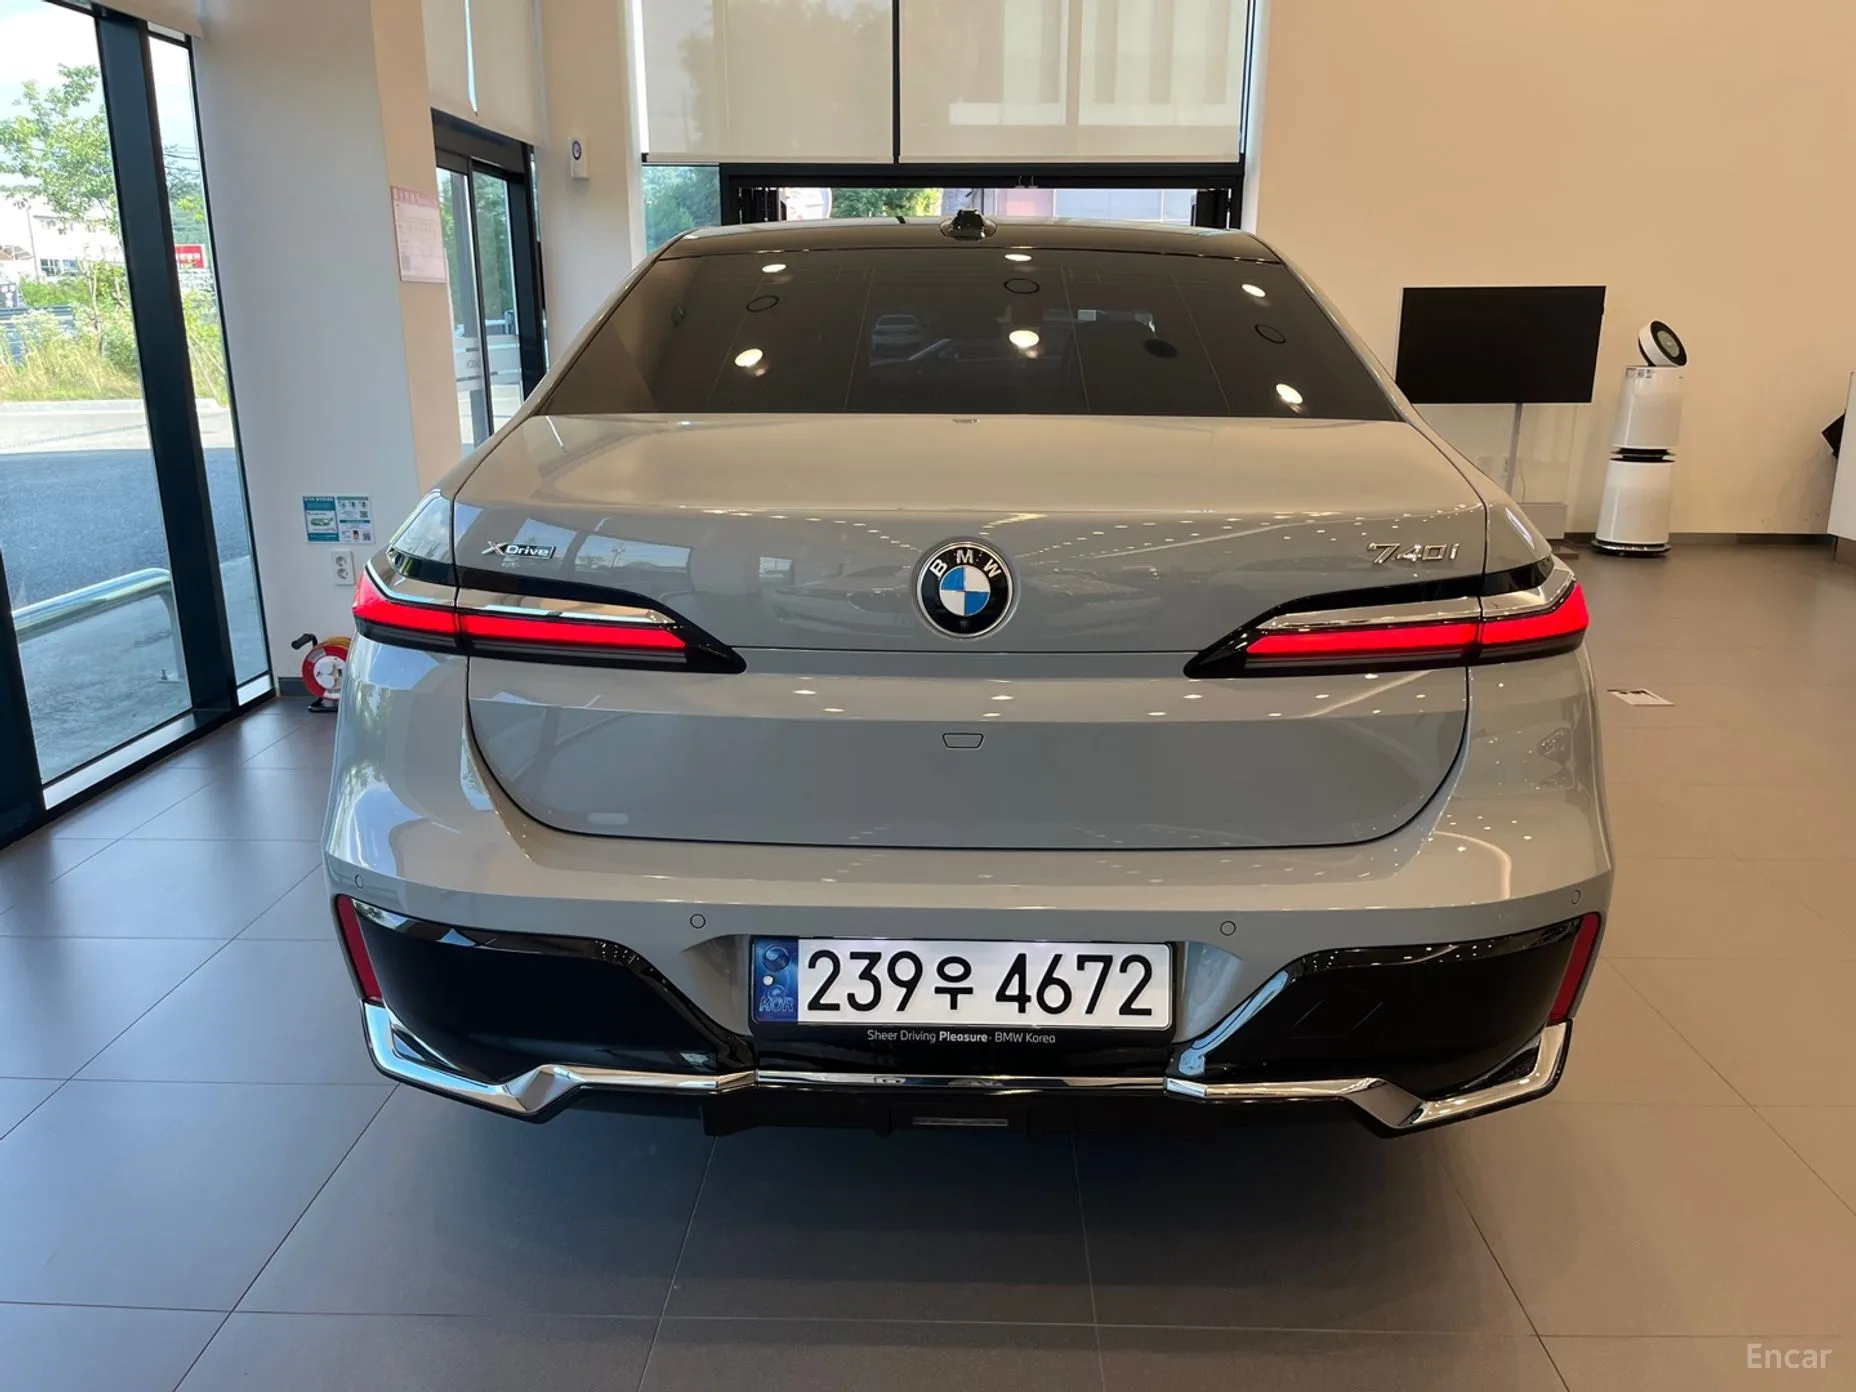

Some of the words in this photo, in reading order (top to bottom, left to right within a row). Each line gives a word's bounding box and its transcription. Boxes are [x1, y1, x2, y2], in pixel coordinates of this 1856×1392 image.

[929, 549, 1002, 578] BMW
[1367, 542, 1460, 564] 740i
[994, 952, 1153, 1016] 4672
[867, 1029, 899, 1042] Sheer
[900, 1030, 937, 1045] Driving
[994, 1032, 1023, 1044] BMW
[1025, 1033, 1057, 1044] Korea
